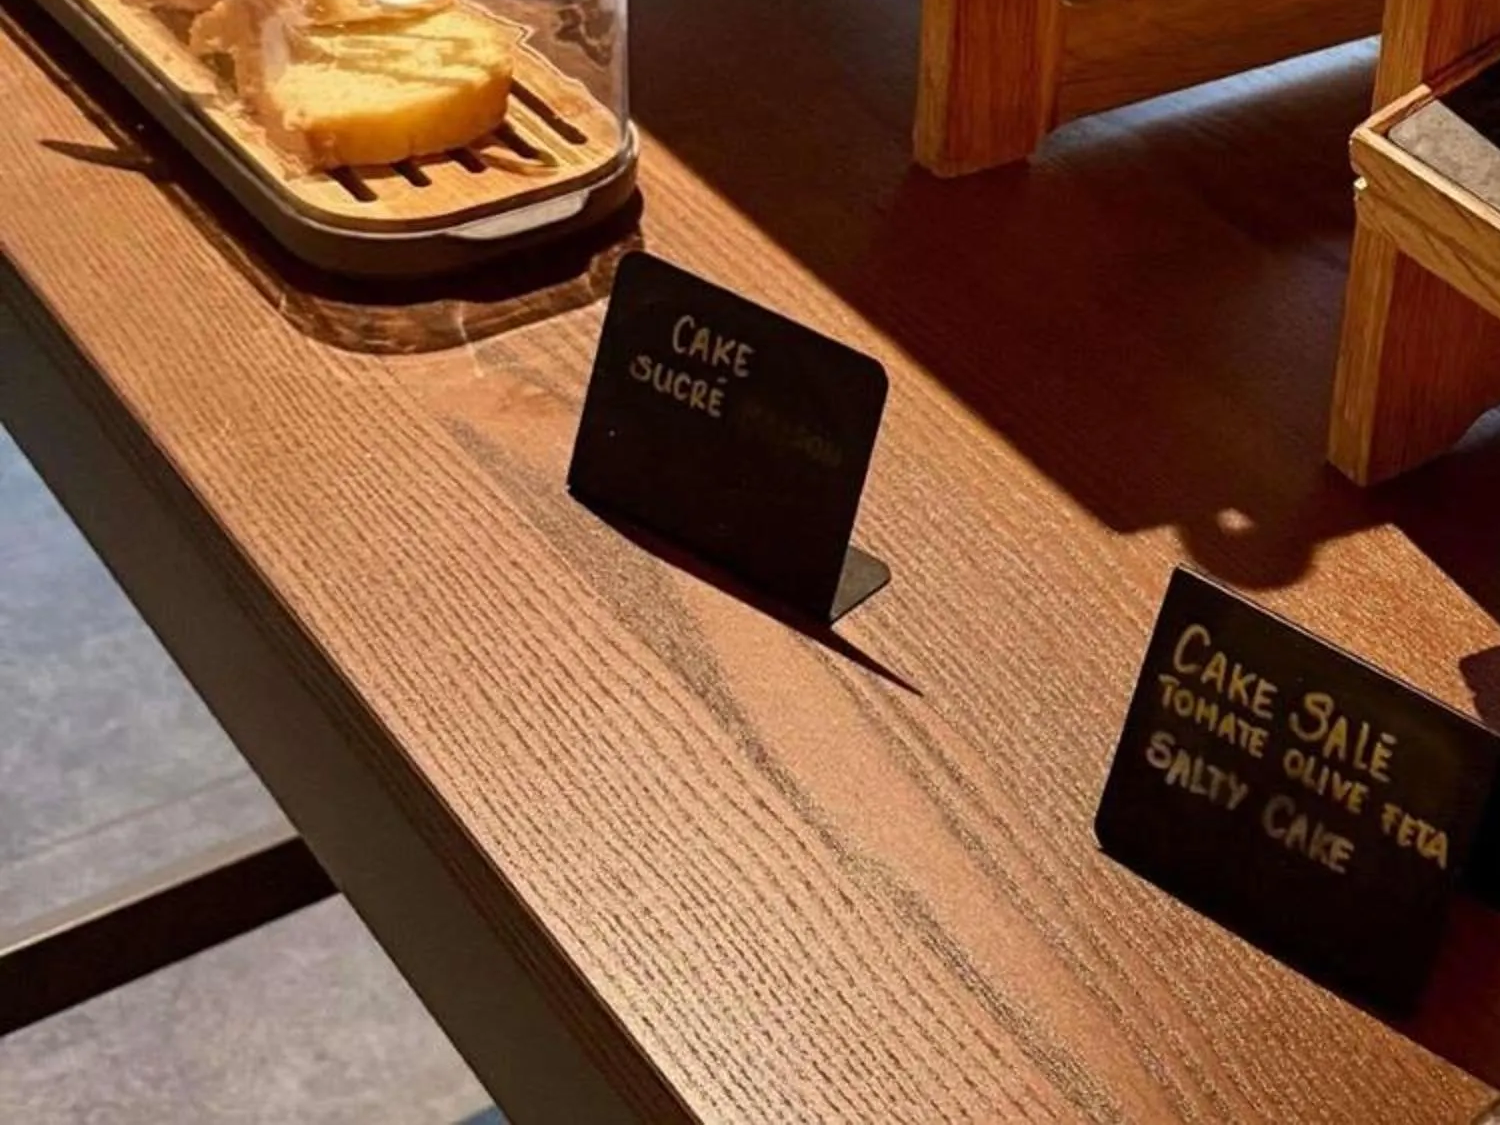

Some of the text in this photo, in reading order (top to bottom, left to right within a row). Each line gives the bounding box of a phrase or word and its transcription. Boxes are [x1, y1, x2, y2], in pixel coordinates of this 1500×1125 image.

[629, 355, 728, 418] SUCRÉ
[672, 315, 756, 377] CAKE
[1157, 675, 1450, 869] TOMATE OLIVE FETA
[1173, 624, 1398, 783] CAKE SALÉ
[1146, 732, 1355, 874] SALTY CAKE
